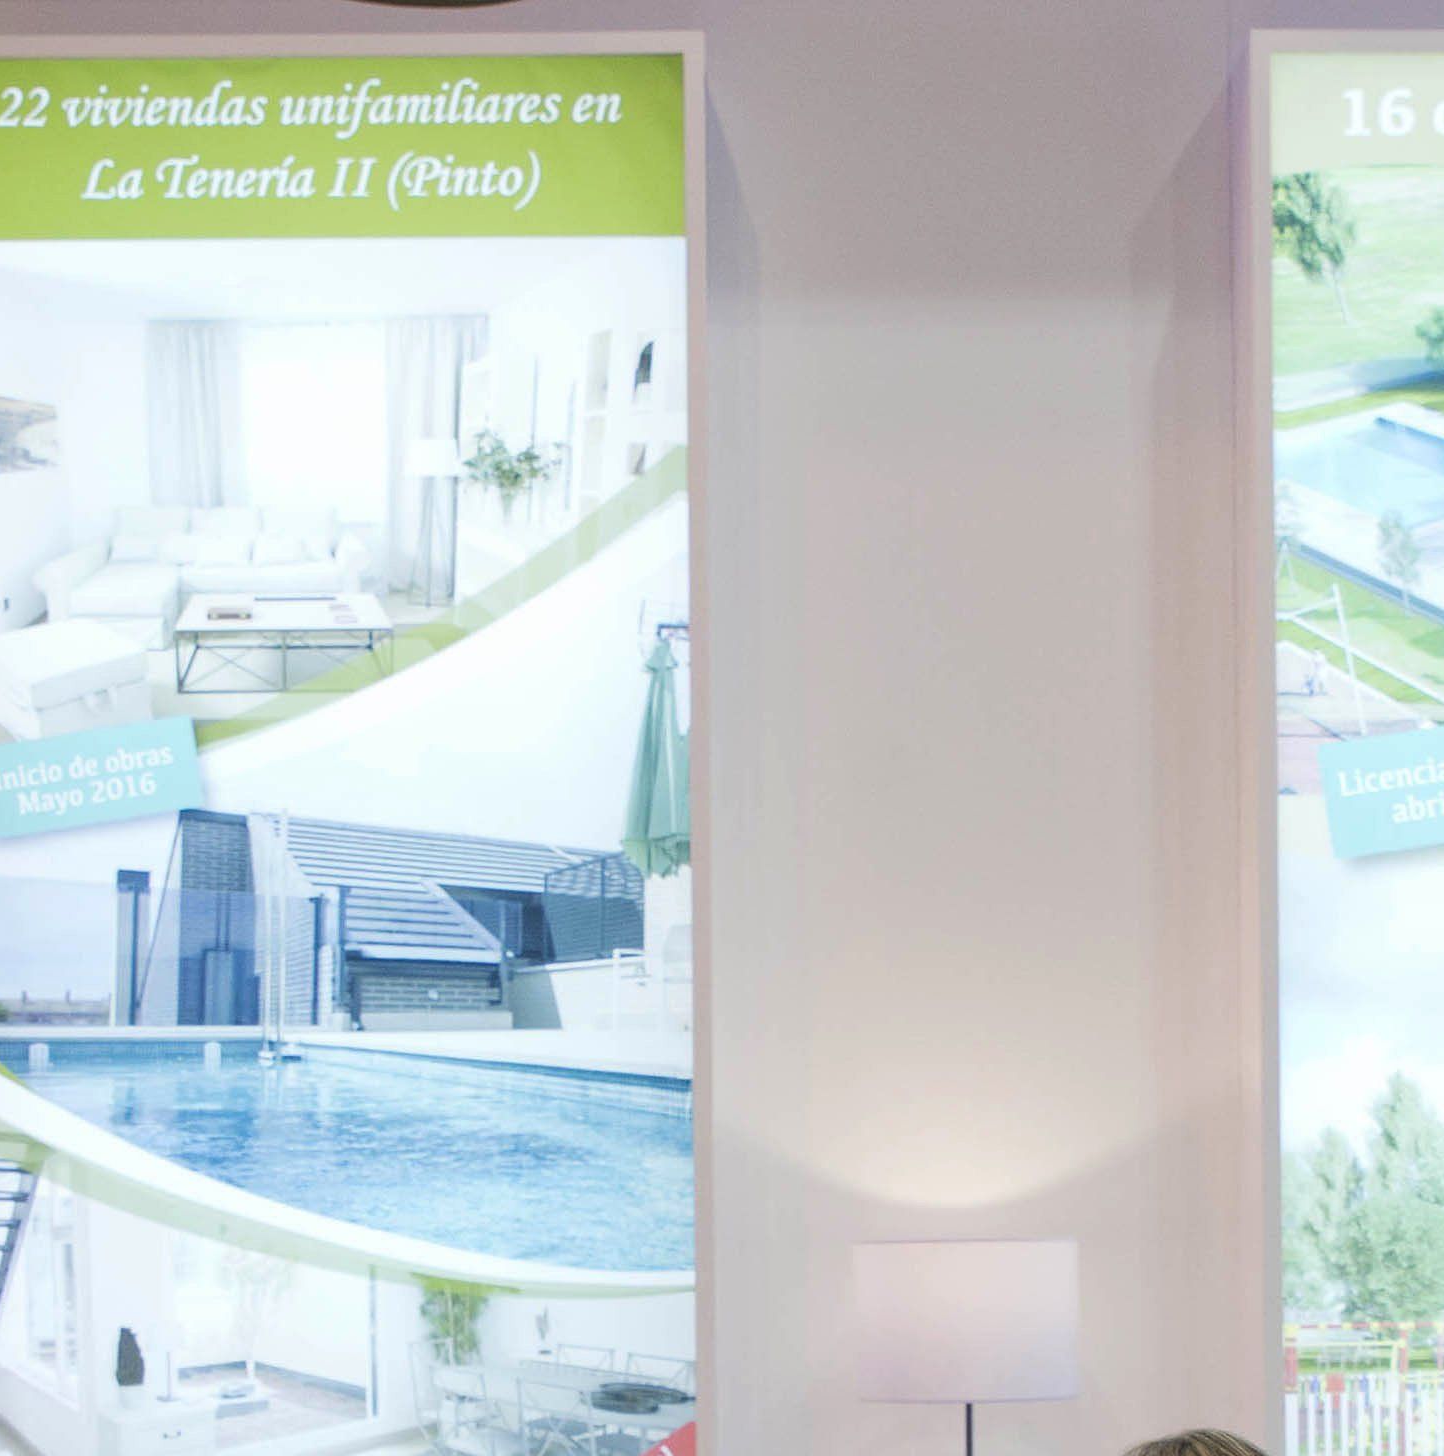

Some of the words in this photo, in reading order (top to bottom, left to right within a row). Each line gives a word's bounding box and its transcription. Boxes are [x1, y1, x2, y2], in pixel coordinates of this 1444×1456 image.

[62, 80, 267, 127] viviendas
[280, 78, 562, 140] unifamiliares
[571, 89, 622, 125] en
[1342, 87, 1416, 138] 16
[80, 158, 144, 201] La
[156, 156, 315, 200] Tenería
[327, 157, 378, 198] II
[386, 151, 541, 212] (Pinto)
[68, 755, 98, 779] de
[104, 746, 174, 773] obras
[16, 787, 83, 815] Mayo
[90, 772, 157, 804] 2016
